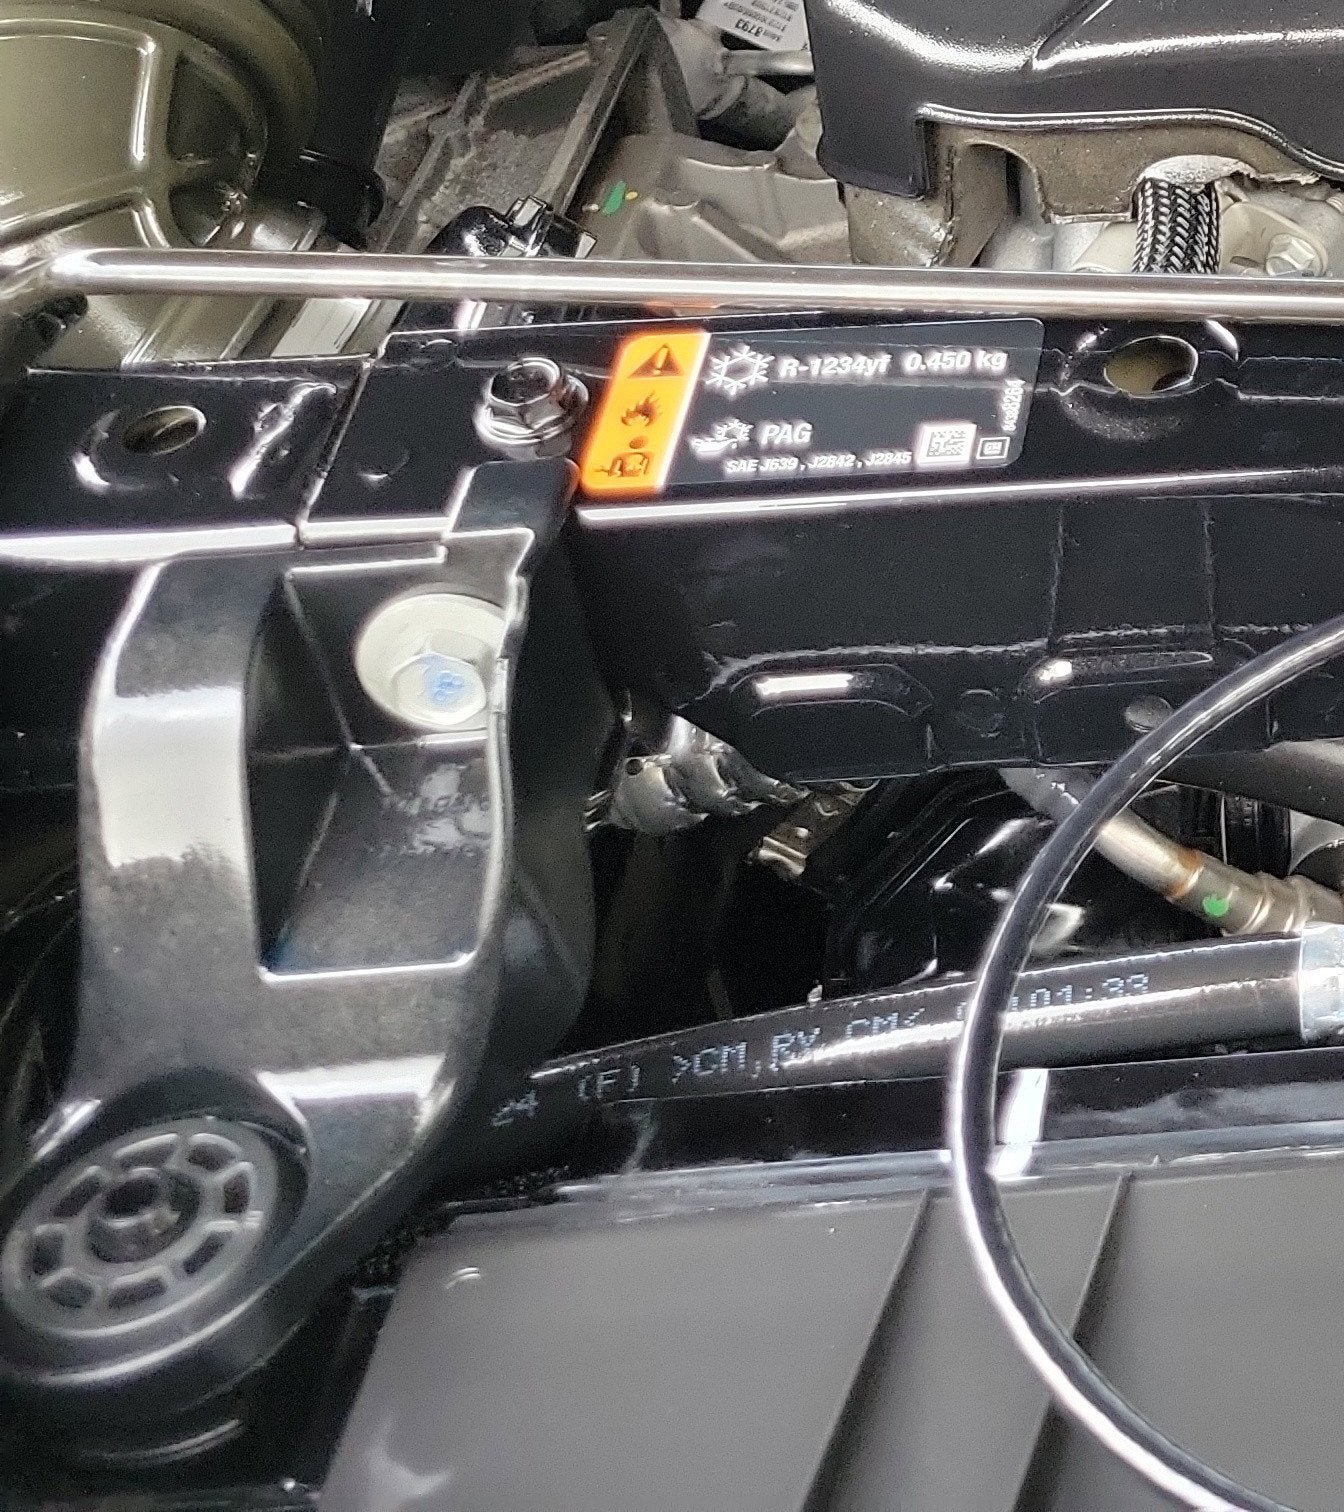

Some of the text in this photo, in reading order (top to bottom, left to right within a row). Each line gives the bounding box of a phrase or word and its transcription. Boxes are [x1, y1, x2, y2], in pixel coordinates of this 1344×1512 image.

[780, 349, 1008, 378] R-1234yf 0.450 kg
[760, 423, 813, 446] PAG
[725, 459, 759, 473] SAE
[865, 451, 912, 467] J2845
